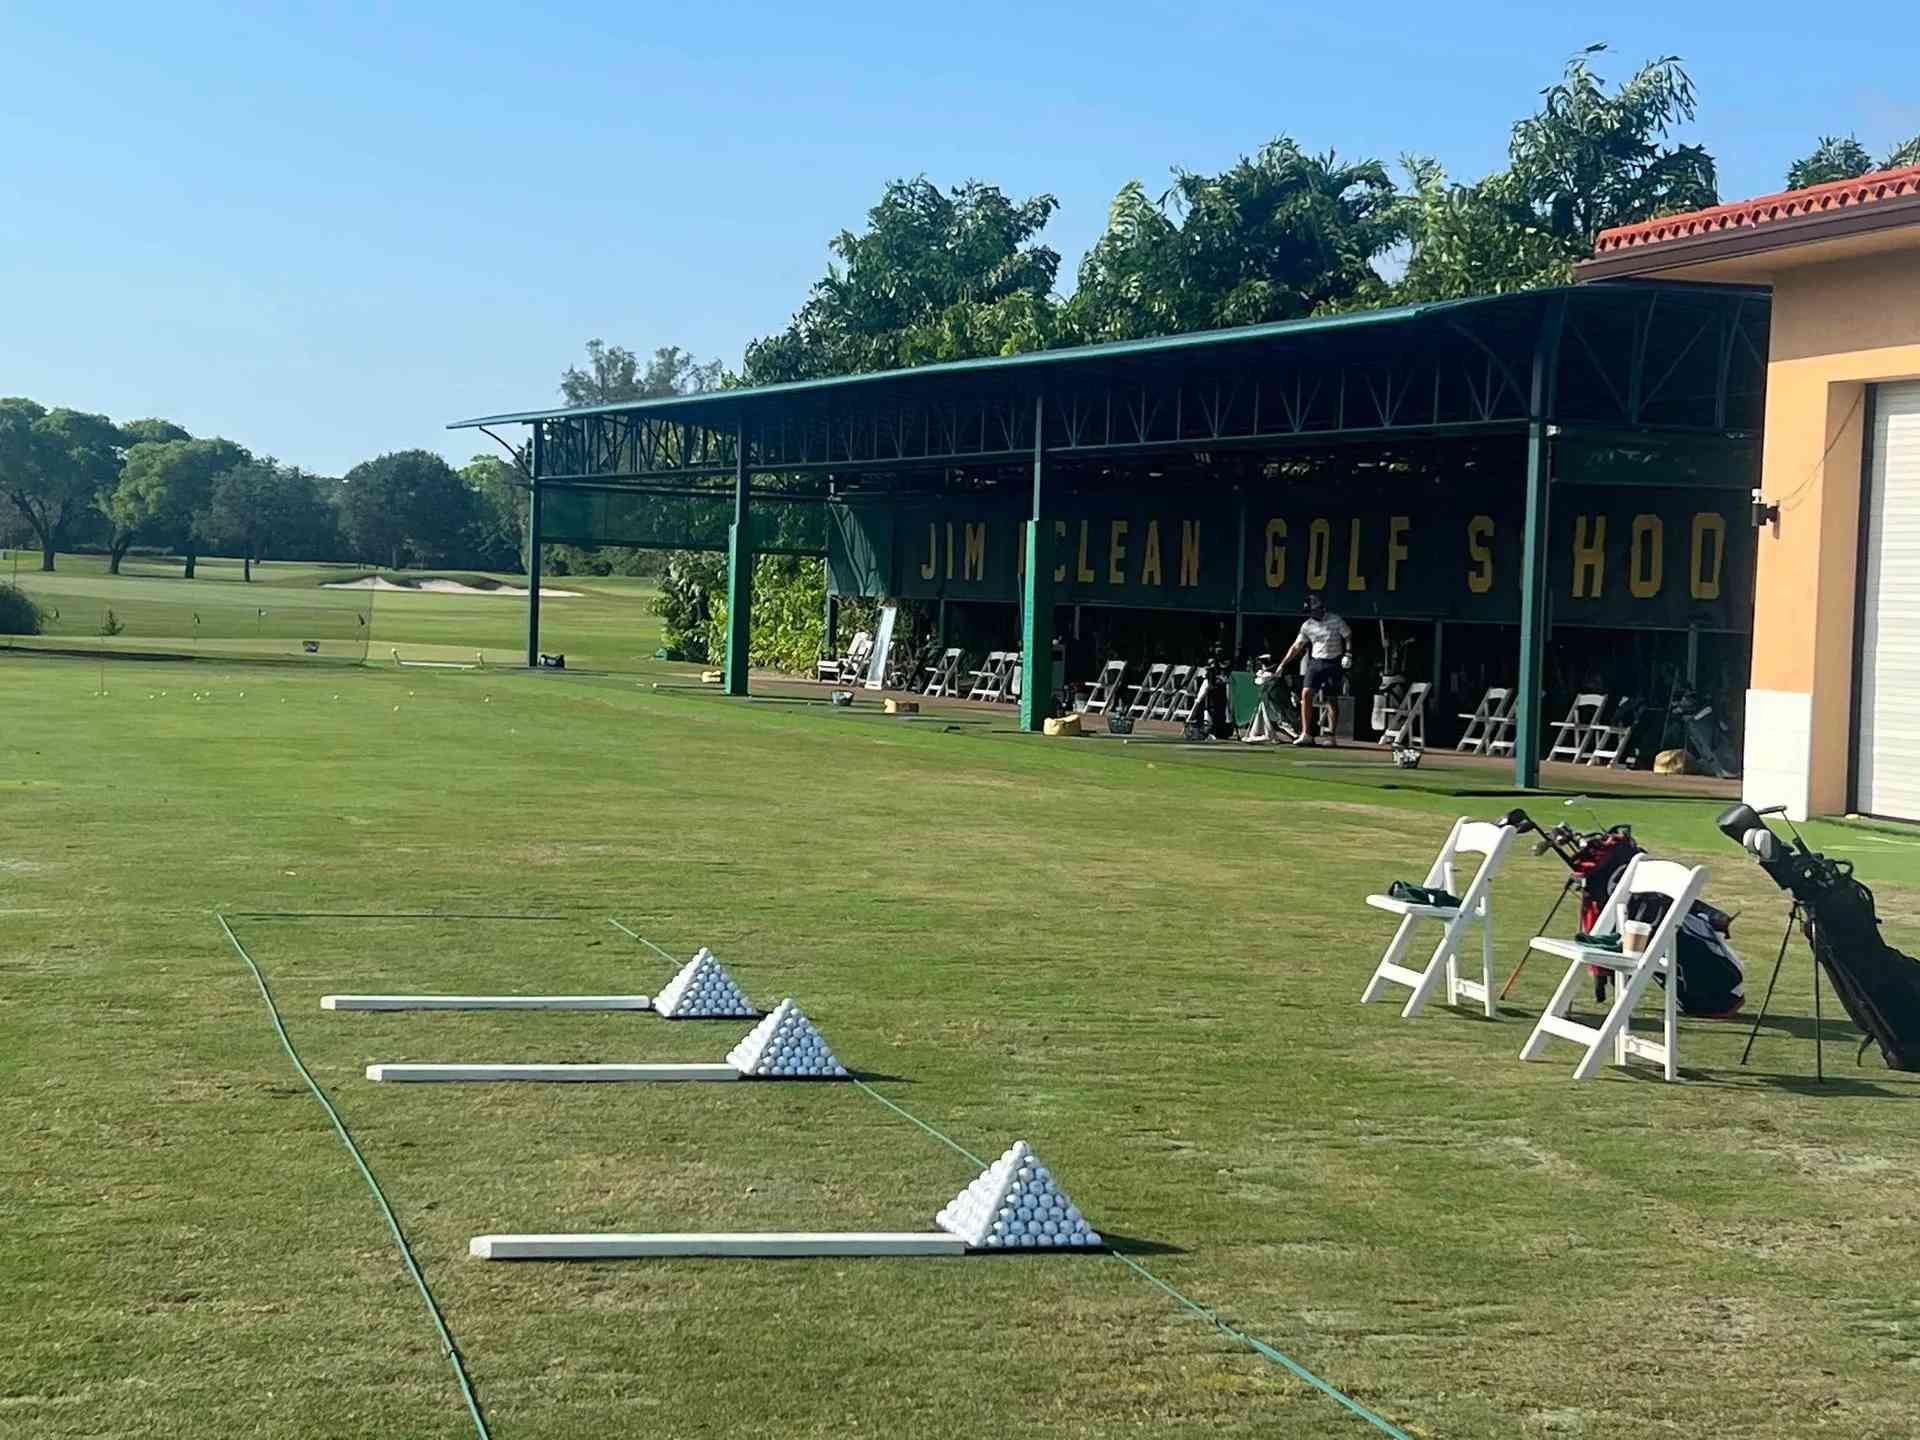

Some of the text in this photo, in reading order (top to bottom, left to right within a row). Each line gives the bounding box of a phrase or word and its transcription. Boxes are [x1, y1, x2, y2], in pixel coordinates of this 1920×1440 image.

[920, 512, 1727, 600] JIM CLEAN GOLF SHOO
